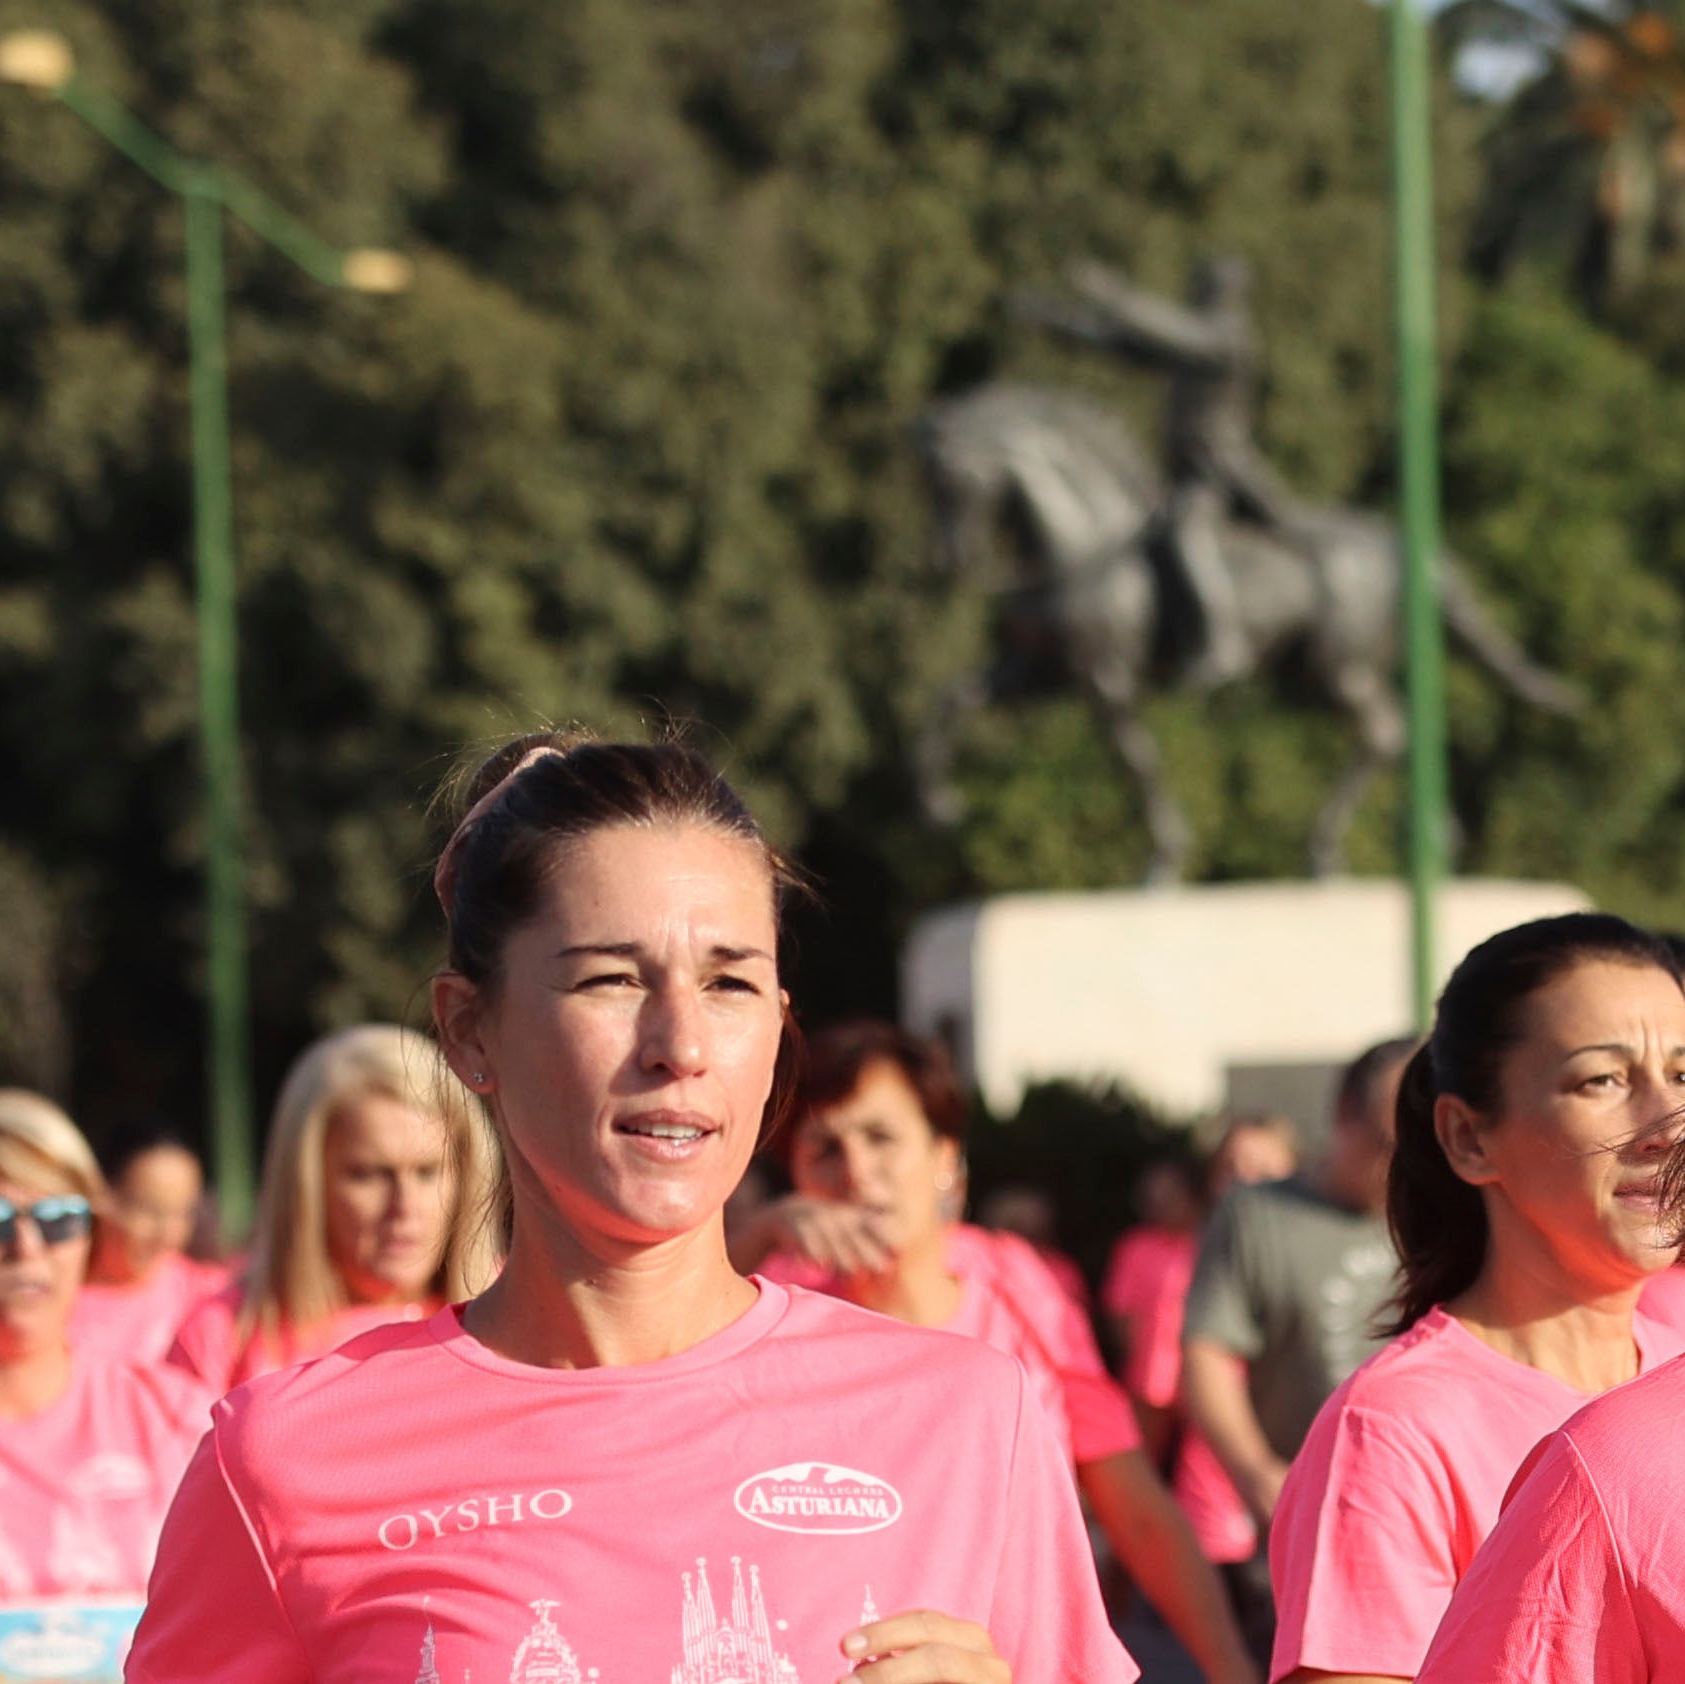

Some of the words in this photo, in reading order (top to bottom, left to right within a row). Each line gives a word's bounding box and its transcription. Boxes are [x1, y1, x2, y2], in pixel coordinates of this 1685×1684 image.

[748, 1486, 891, 1519] ASTURIANA
[771, 1485, 825, 1495] CENTRAL
[378, 1488, 573, 1551] OYSHO
